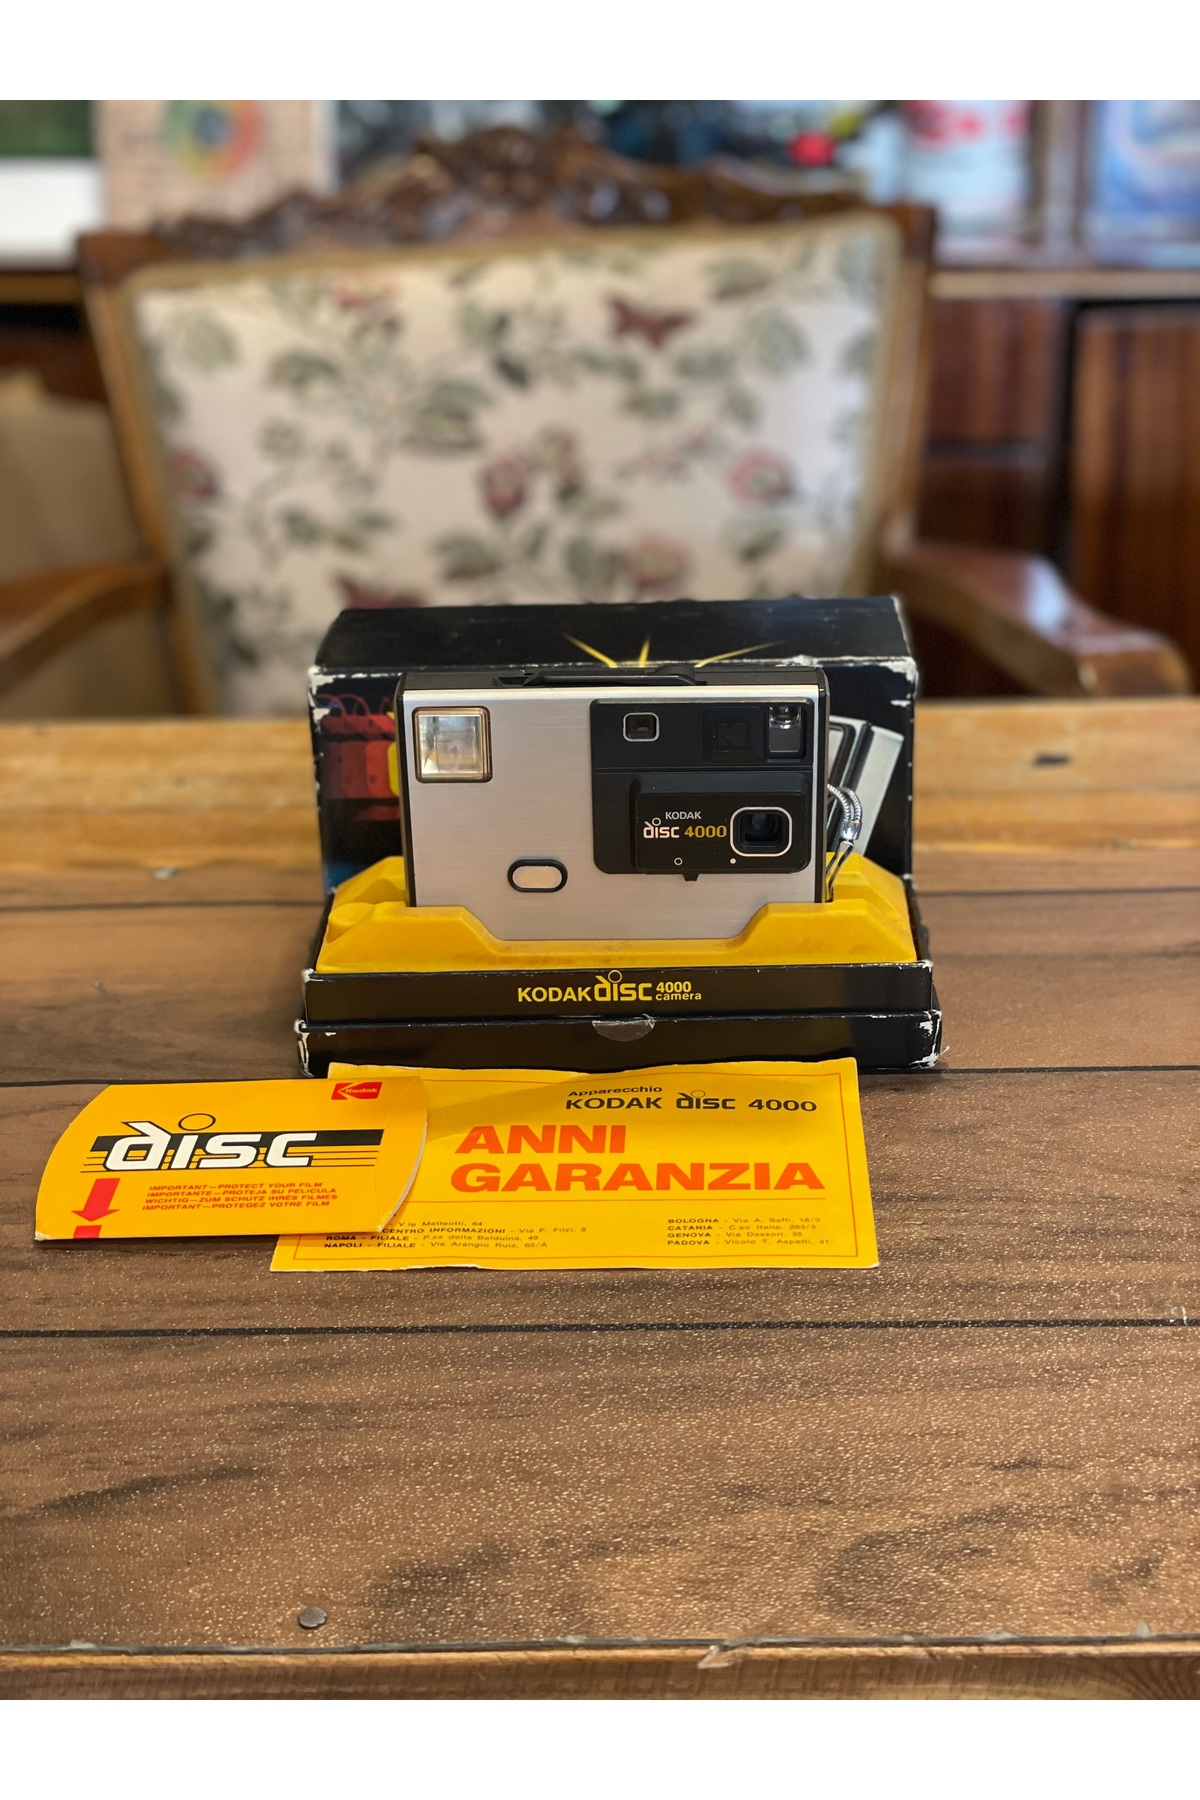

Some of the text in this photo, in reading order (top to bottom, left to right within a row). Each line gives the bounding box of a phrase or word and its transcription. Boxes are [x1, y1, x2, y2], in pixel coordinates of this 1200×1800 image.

[665, 811, 702, 821] KODAK
[643, 817, 727, 839] disc 4000
[517, 969, 692, 1002] KODAK disc 4000
[655, 992, 702, 1001] camera
[566, 1089, 818, 1112] KODAK disc 4000
[568, 1085, 663, 1097] Apparecchio
[102, 1112, 318, 1172] disc
[454, 1124, 627, 1154] ANNI
[450, 1162, 826, 1193] GARANZIA
[224, 1195, 266, 1203] SCHUTZ
